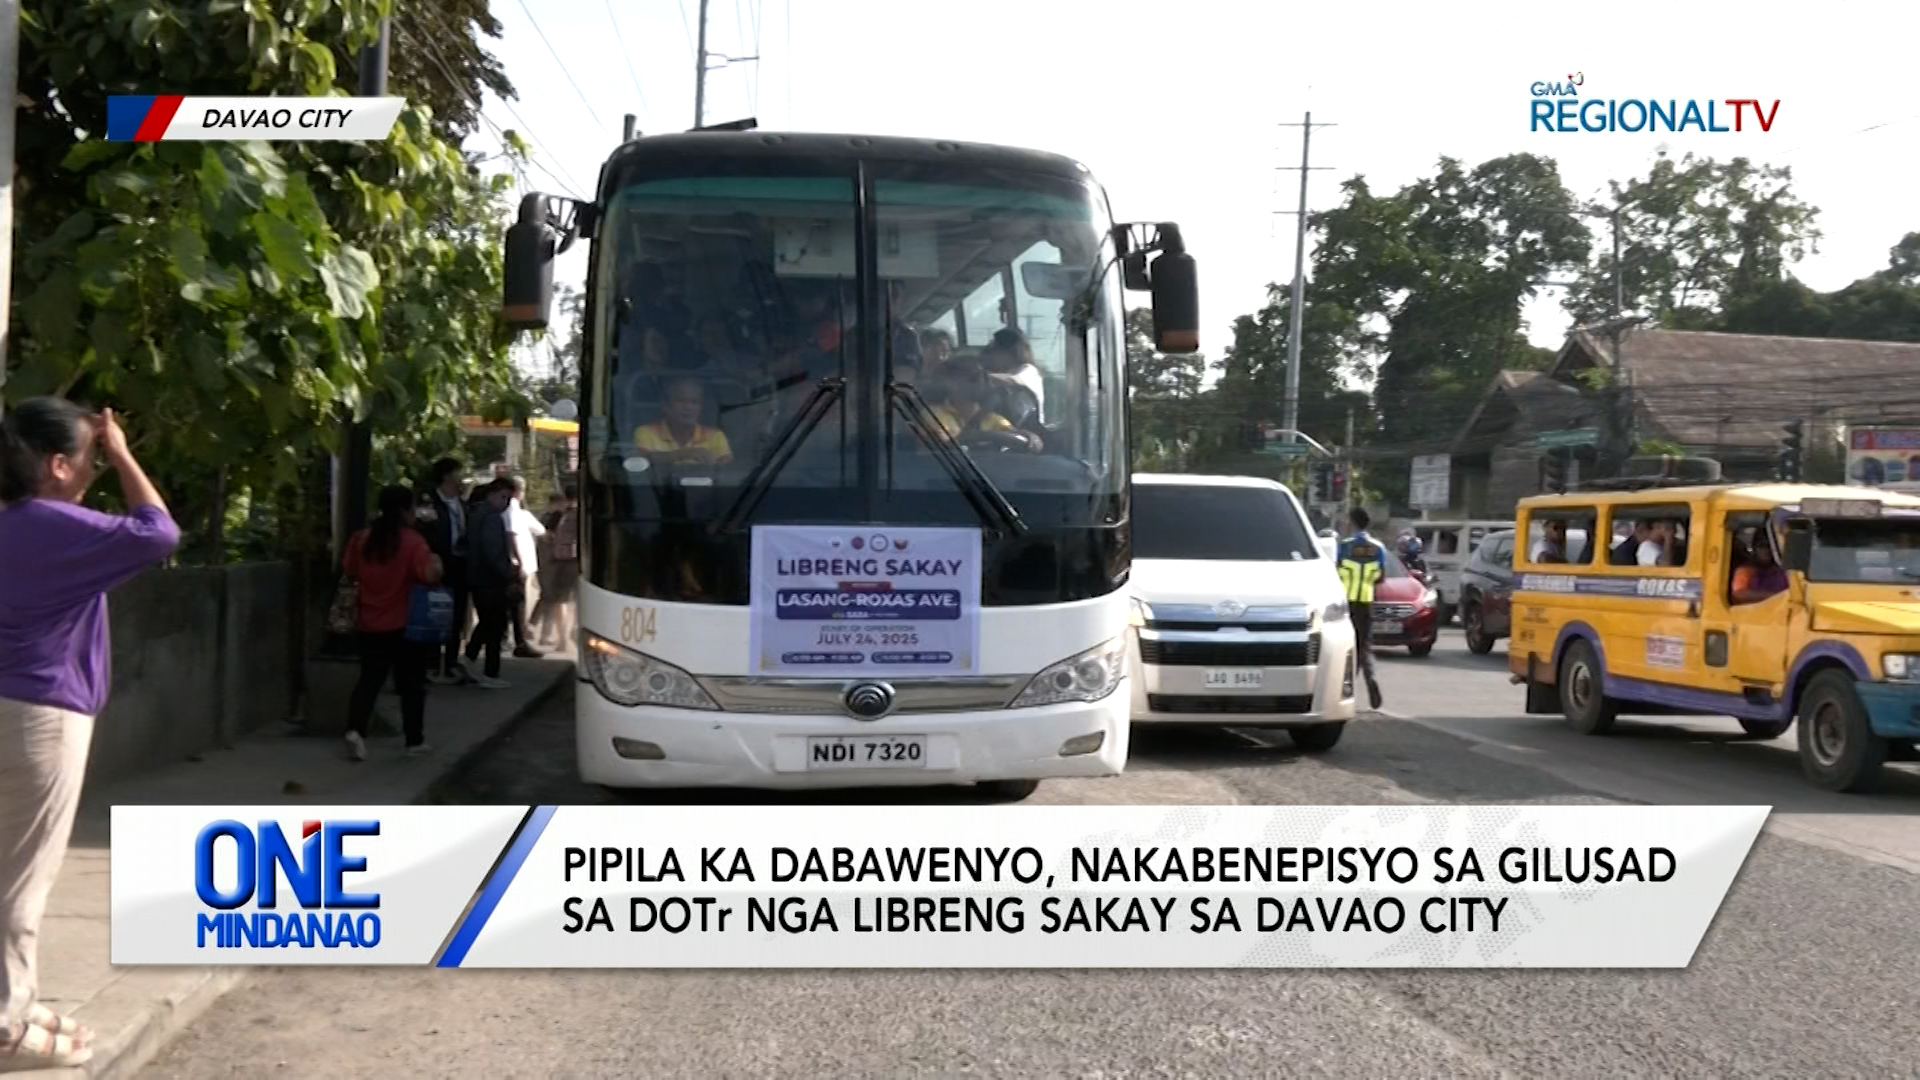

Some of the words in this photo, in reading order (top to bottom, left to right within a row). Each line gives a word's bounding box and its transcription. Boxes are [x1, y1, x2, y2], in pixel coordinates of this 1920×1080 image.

[777, 558, 879, 577] LIBRENG
[885, 558, 963, 577] SAKAY
[777, 592, 916, 607] LASANG-ROXAS
[919, 592, 959, 607] AVE.
[620, 607, 657, 643] 804
[816, 633, 852, 646] JULY
[855, 633, 878, 646] 24,
[881, 633, 919, 645] 2025
[813, 744, 855, 762] NDI
[864, 743, 921, 762] 7320
